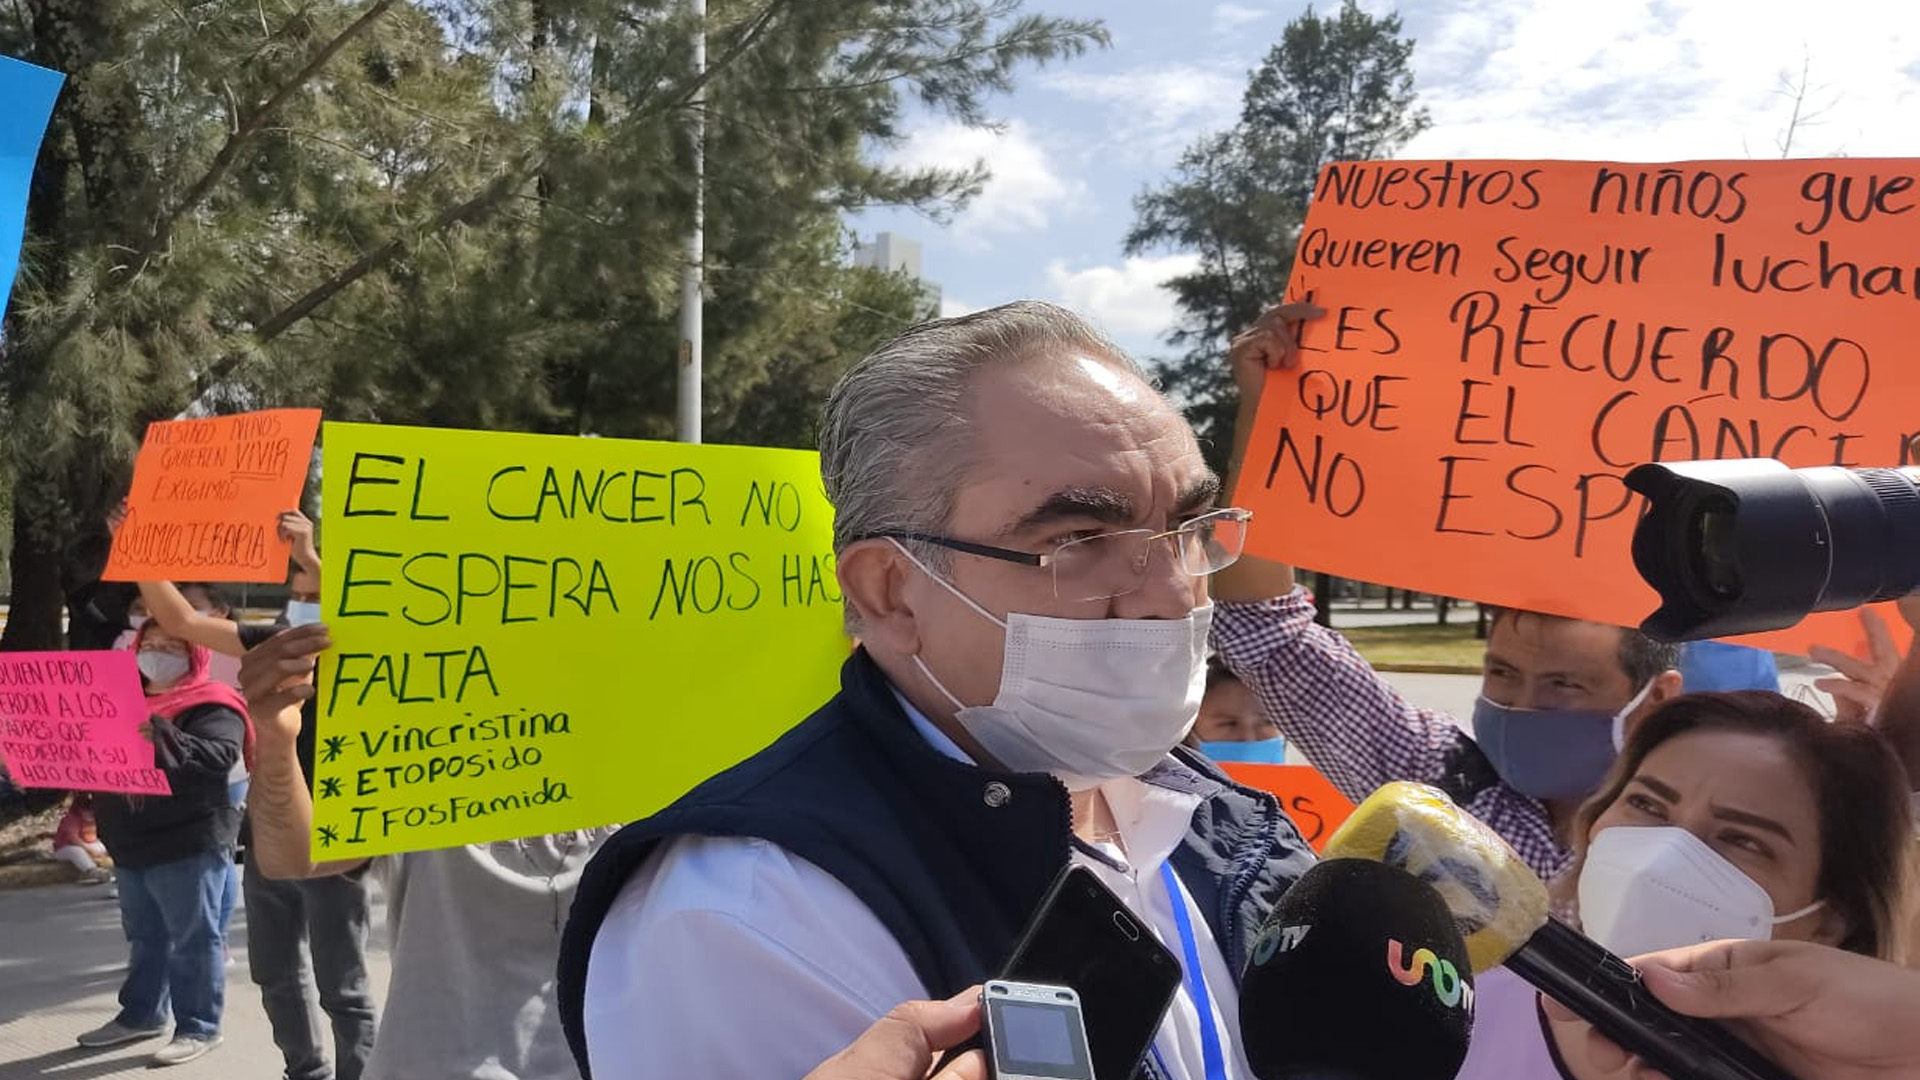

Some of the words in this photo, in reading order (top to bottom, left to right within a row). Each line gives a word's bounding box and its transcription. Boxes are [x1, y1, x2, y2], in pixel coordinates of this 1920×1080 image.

[1590, 168, 1747, 224] niños
[1300, 226, 1461, 277] Quieren
[1450, 290, 1870, 422] RECUERDO
[1298, 369, 1408, 431] QUE
[1454, 378, 1533, 447] EL
[343, 452, 450, 521] EL
[487, 466, 711, 526] CANCER
[740, 480, 801, 532] NO
[1266, 426, 1366, 518] NO
[1434, 455, 1638, 558] ESP
[337, 548, 620, 627] ESPERA
[648, 552, 760, 621] NOS
[58, 692, 75, 718] A
[76, 692, 118, 719] LOS
[326, 644, 501, 717] FALTA
